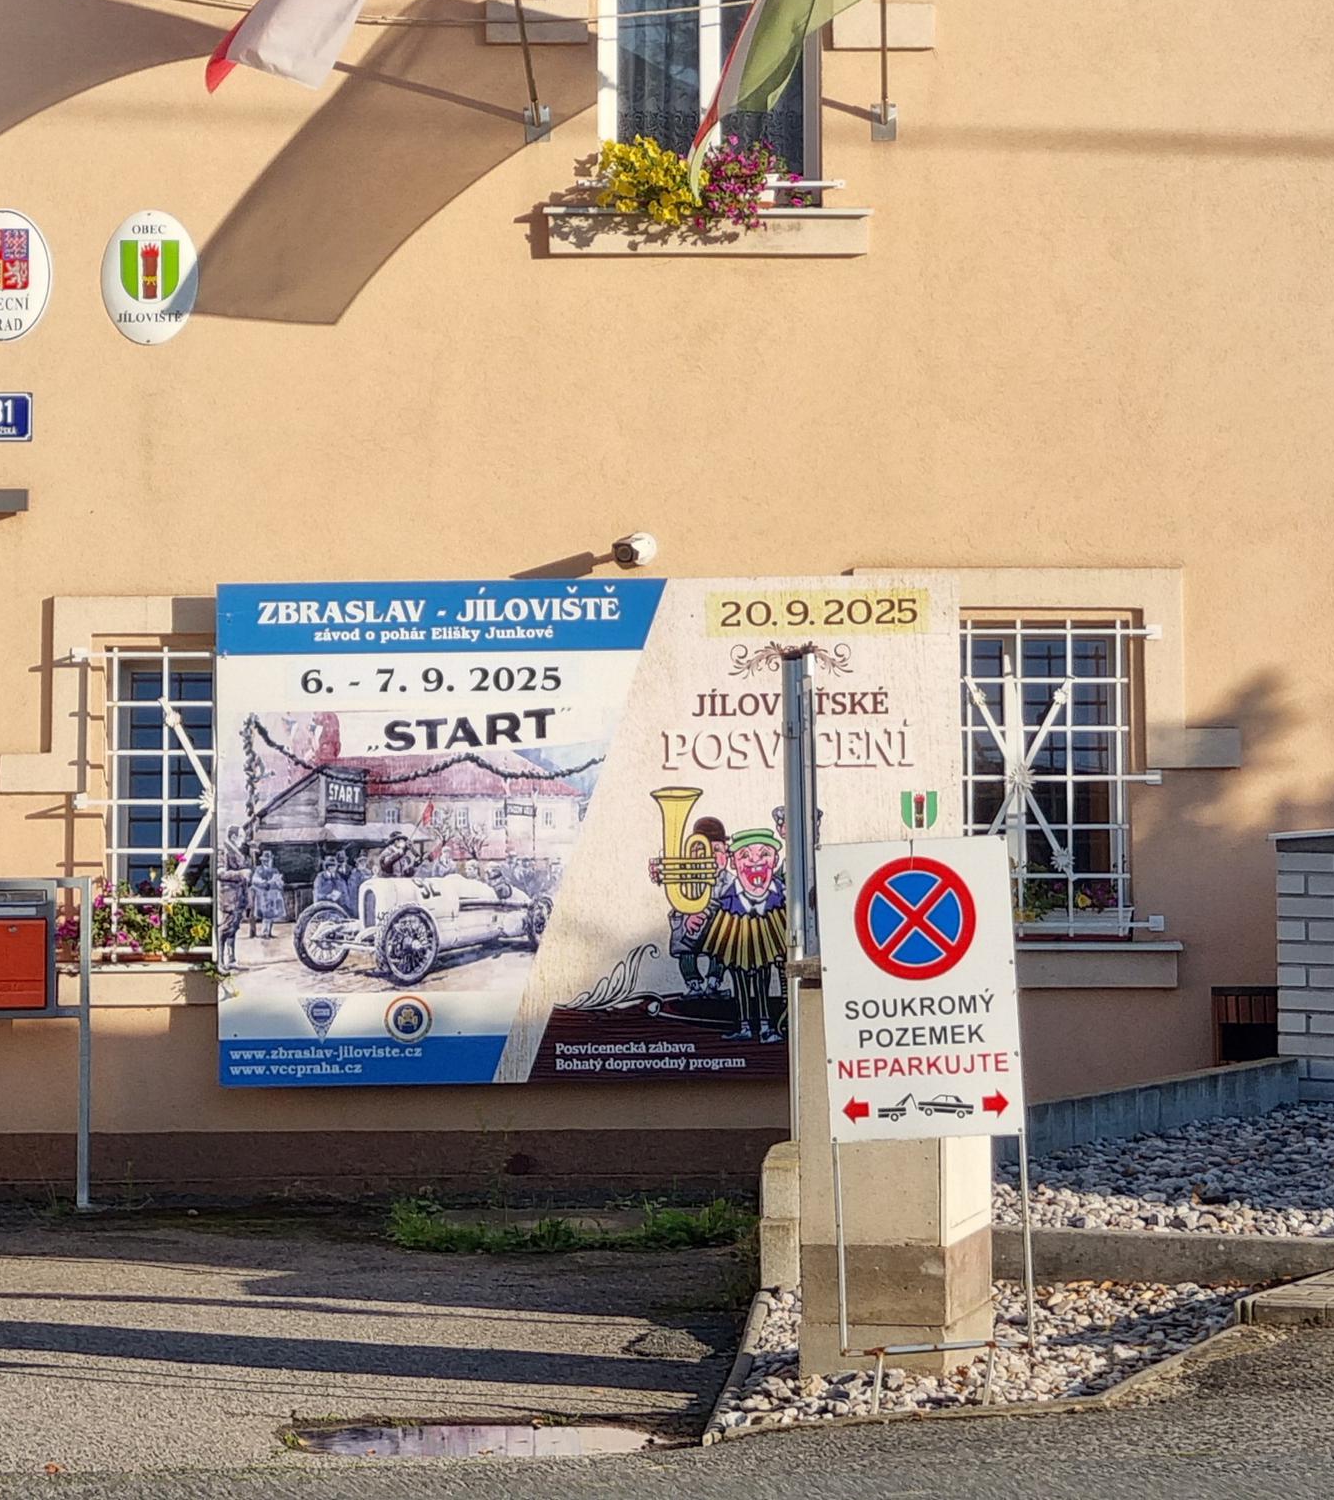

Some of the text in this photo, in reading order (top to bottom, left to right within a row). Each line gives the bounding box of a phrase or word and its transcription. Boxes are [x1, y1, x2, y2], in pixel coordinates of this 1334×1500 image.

[131, 224, 167, 235] OBEC
[116, 308, 183, 324] JÍLOVIŠTĚ
[257, 599, 426, 626] ZBRASLAV
[456, 586, 621, 623] JÍLOVIŠTĚ
[720, 598, 918, 628] 20. 9. 2025
[313, 625, 554, 644] závod o pohár Elišky Junkové
[300, 668, 334, 694] 6.
[375, 668, 407, 693] 7.
[422, 667, 455, 692] 9.
[469, 666, 562, 692] 2025
[692, 686, 889, 717] JÍLOVŤSKÉ
[661, 718, 915, 771] POSVCENÍ
[328, 782, 361, 804] START
[844, 988, 995, 1020] SOUKROMÝ
[648, 1041, 696, 1054] zábava
[858, 1023, 986, 1049] POZEMEK
[229, 1045, 423, 1061] www.zbraslav-jiloviste.cz
[555, 1057, 746, 1072] Bohatý doprovodný program
[229, 1062, 363, 1078] www.vccpraha.cz
[837, 1052, 1010, 1079] NEPARKUJTE
